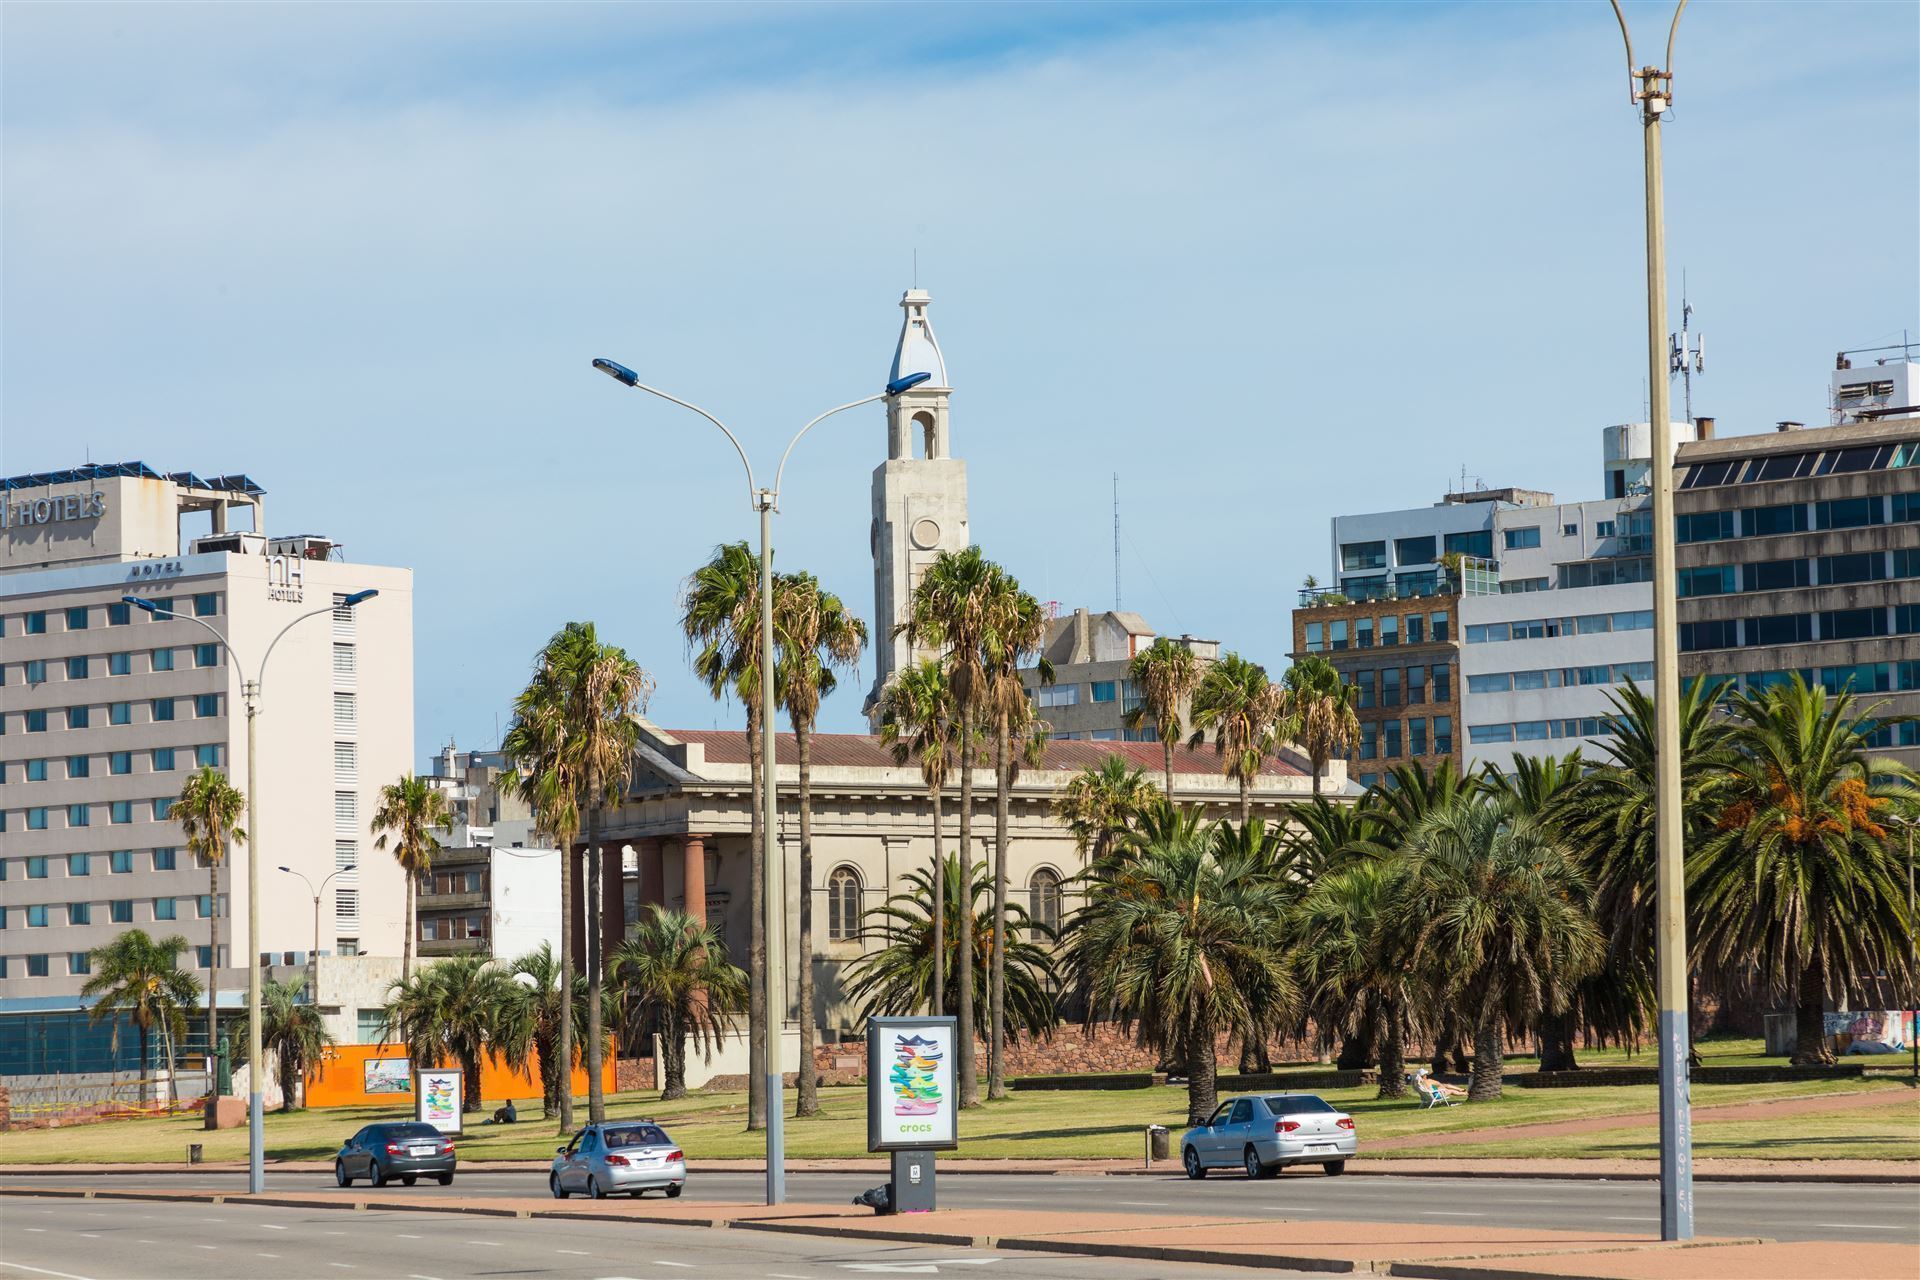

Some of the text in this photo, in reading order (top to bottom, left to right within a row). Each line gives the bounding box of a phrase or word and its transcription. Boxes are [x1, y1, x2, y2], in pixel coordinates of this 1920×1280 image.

[19, 491, 106, 526] HOTELS
[131, 561, 184, 577] HOTEL
[269, 589, 303, 604] HOTELS
[900, 1124, 933, 1133] crocs
